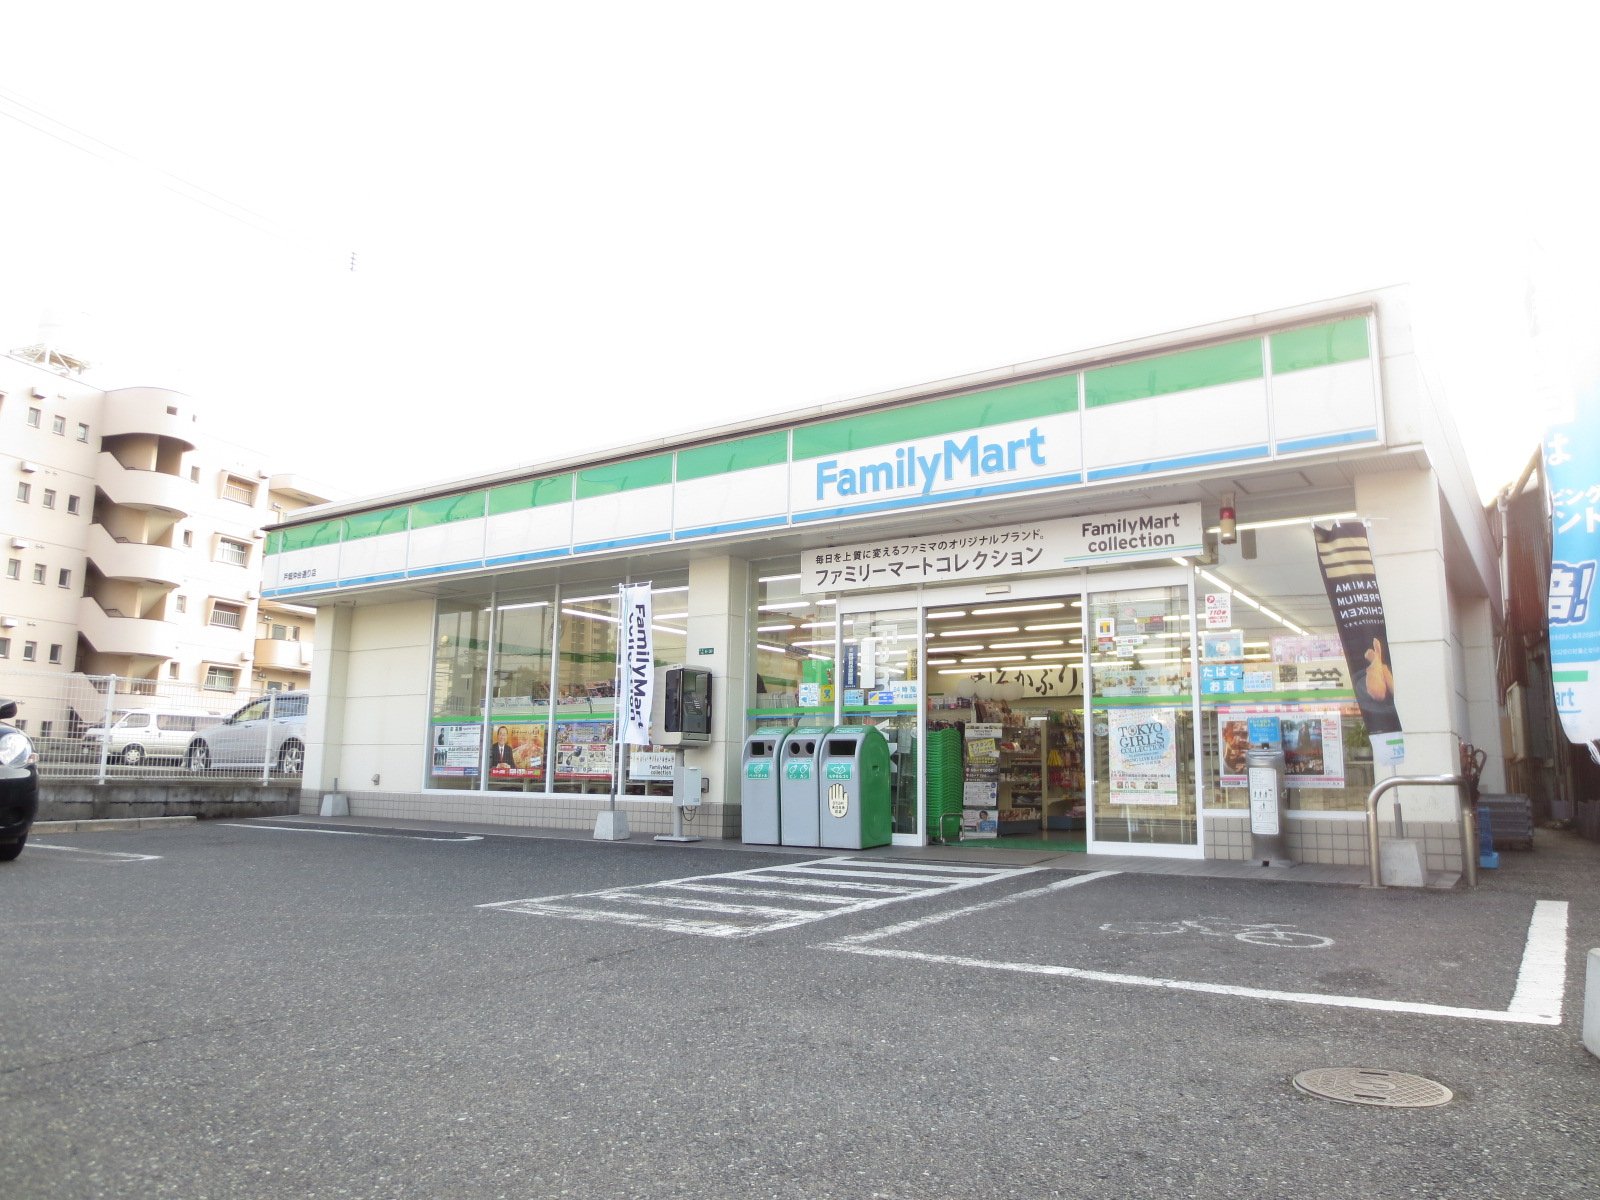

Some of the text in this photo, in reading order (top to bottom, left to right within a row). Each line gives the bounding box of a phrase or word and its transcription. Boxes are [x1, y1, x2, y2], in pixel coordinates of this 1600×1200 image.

[816, 426, 1046, 500] FamilyMart
[1082, 512, 1180, 538] FamilyMart
[815, 529, 1044, 565] 毎日を上質に変えるファミマのオリジナルブランド。
[1088, 532, 1175, 553] collection
[815, 547, 1043, 587] ファミリーマートコレクション
[631, 604, 650, 728] FamilyMart
[1203, 666, 1240, 678] たばこ
[1209, 681, 1235, 692] お酒
[1118, 722, 1163, 738] TOKYO
[1119, 732, 1165, 749] GIRLS
[1120, 744, 1165, 755] COLLECTION
